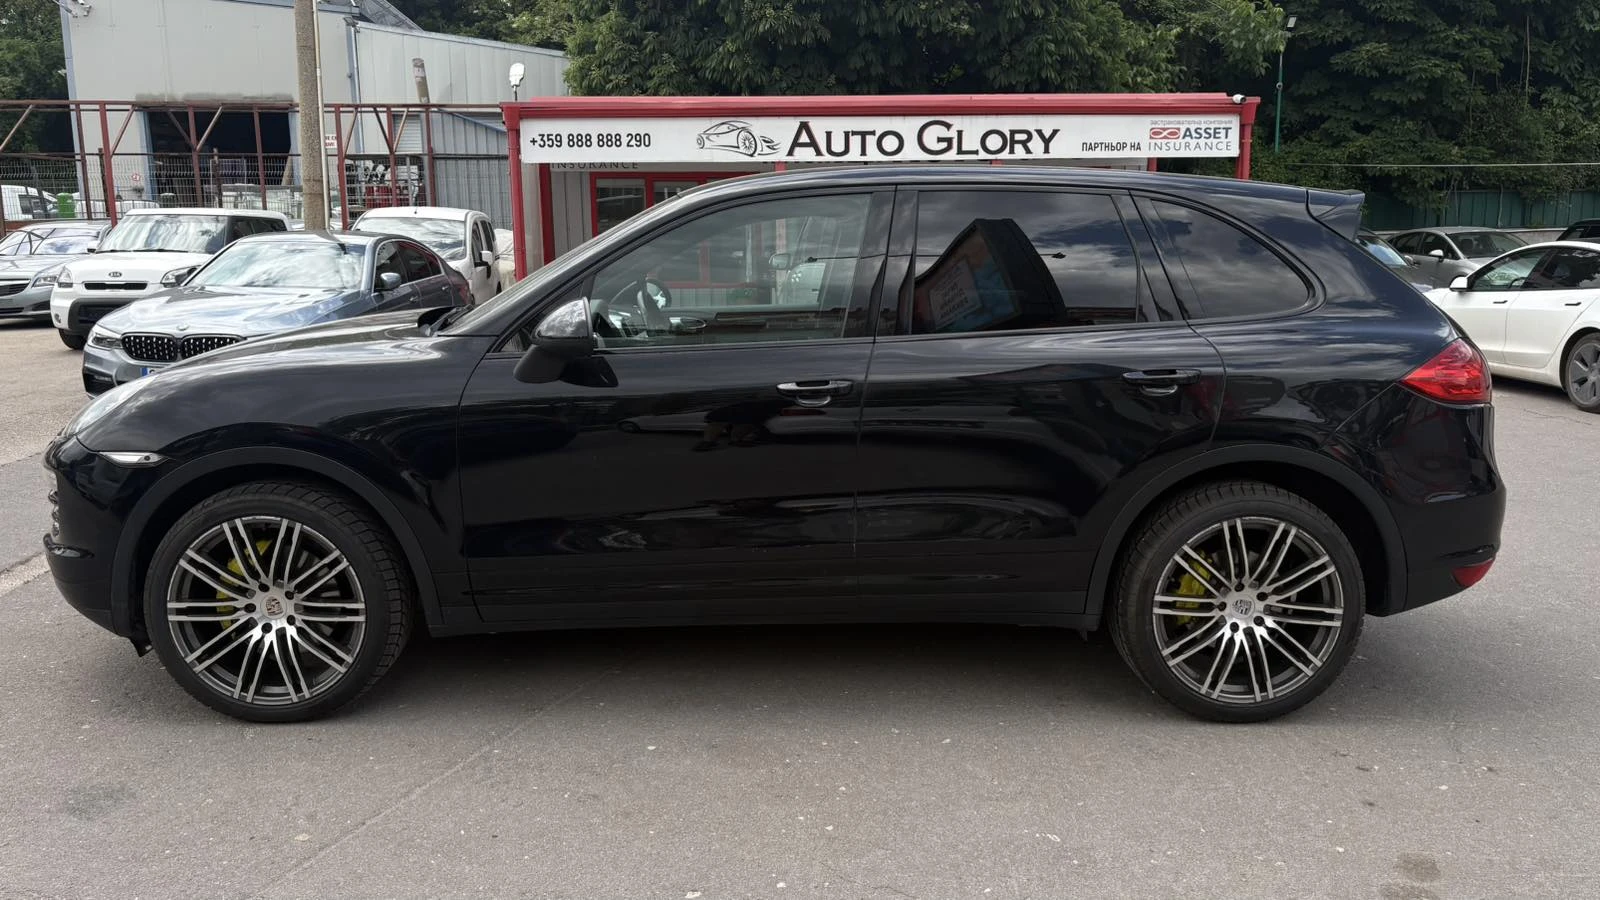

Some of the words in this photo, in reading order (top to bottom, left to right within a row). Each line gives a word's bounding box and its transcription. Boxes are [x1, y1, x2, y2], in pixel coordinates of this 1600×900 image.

[786, 120, 905, 157] AUTO
[917, 119, 1061, 156] GLORY
[1182, 127, 1232, 139] ASSET
[529, 132, 563, 148] +359
[567, 132, 593, 147] 888
[597, 132, 622, 147] 888
[626, 132, 651, 147] 290
[1148, 140, 1232, 151] INSURANCE
[1081, 141, 1128, 152] ПАРТНЬОР
[1129, 141, 1142, 152] НА
